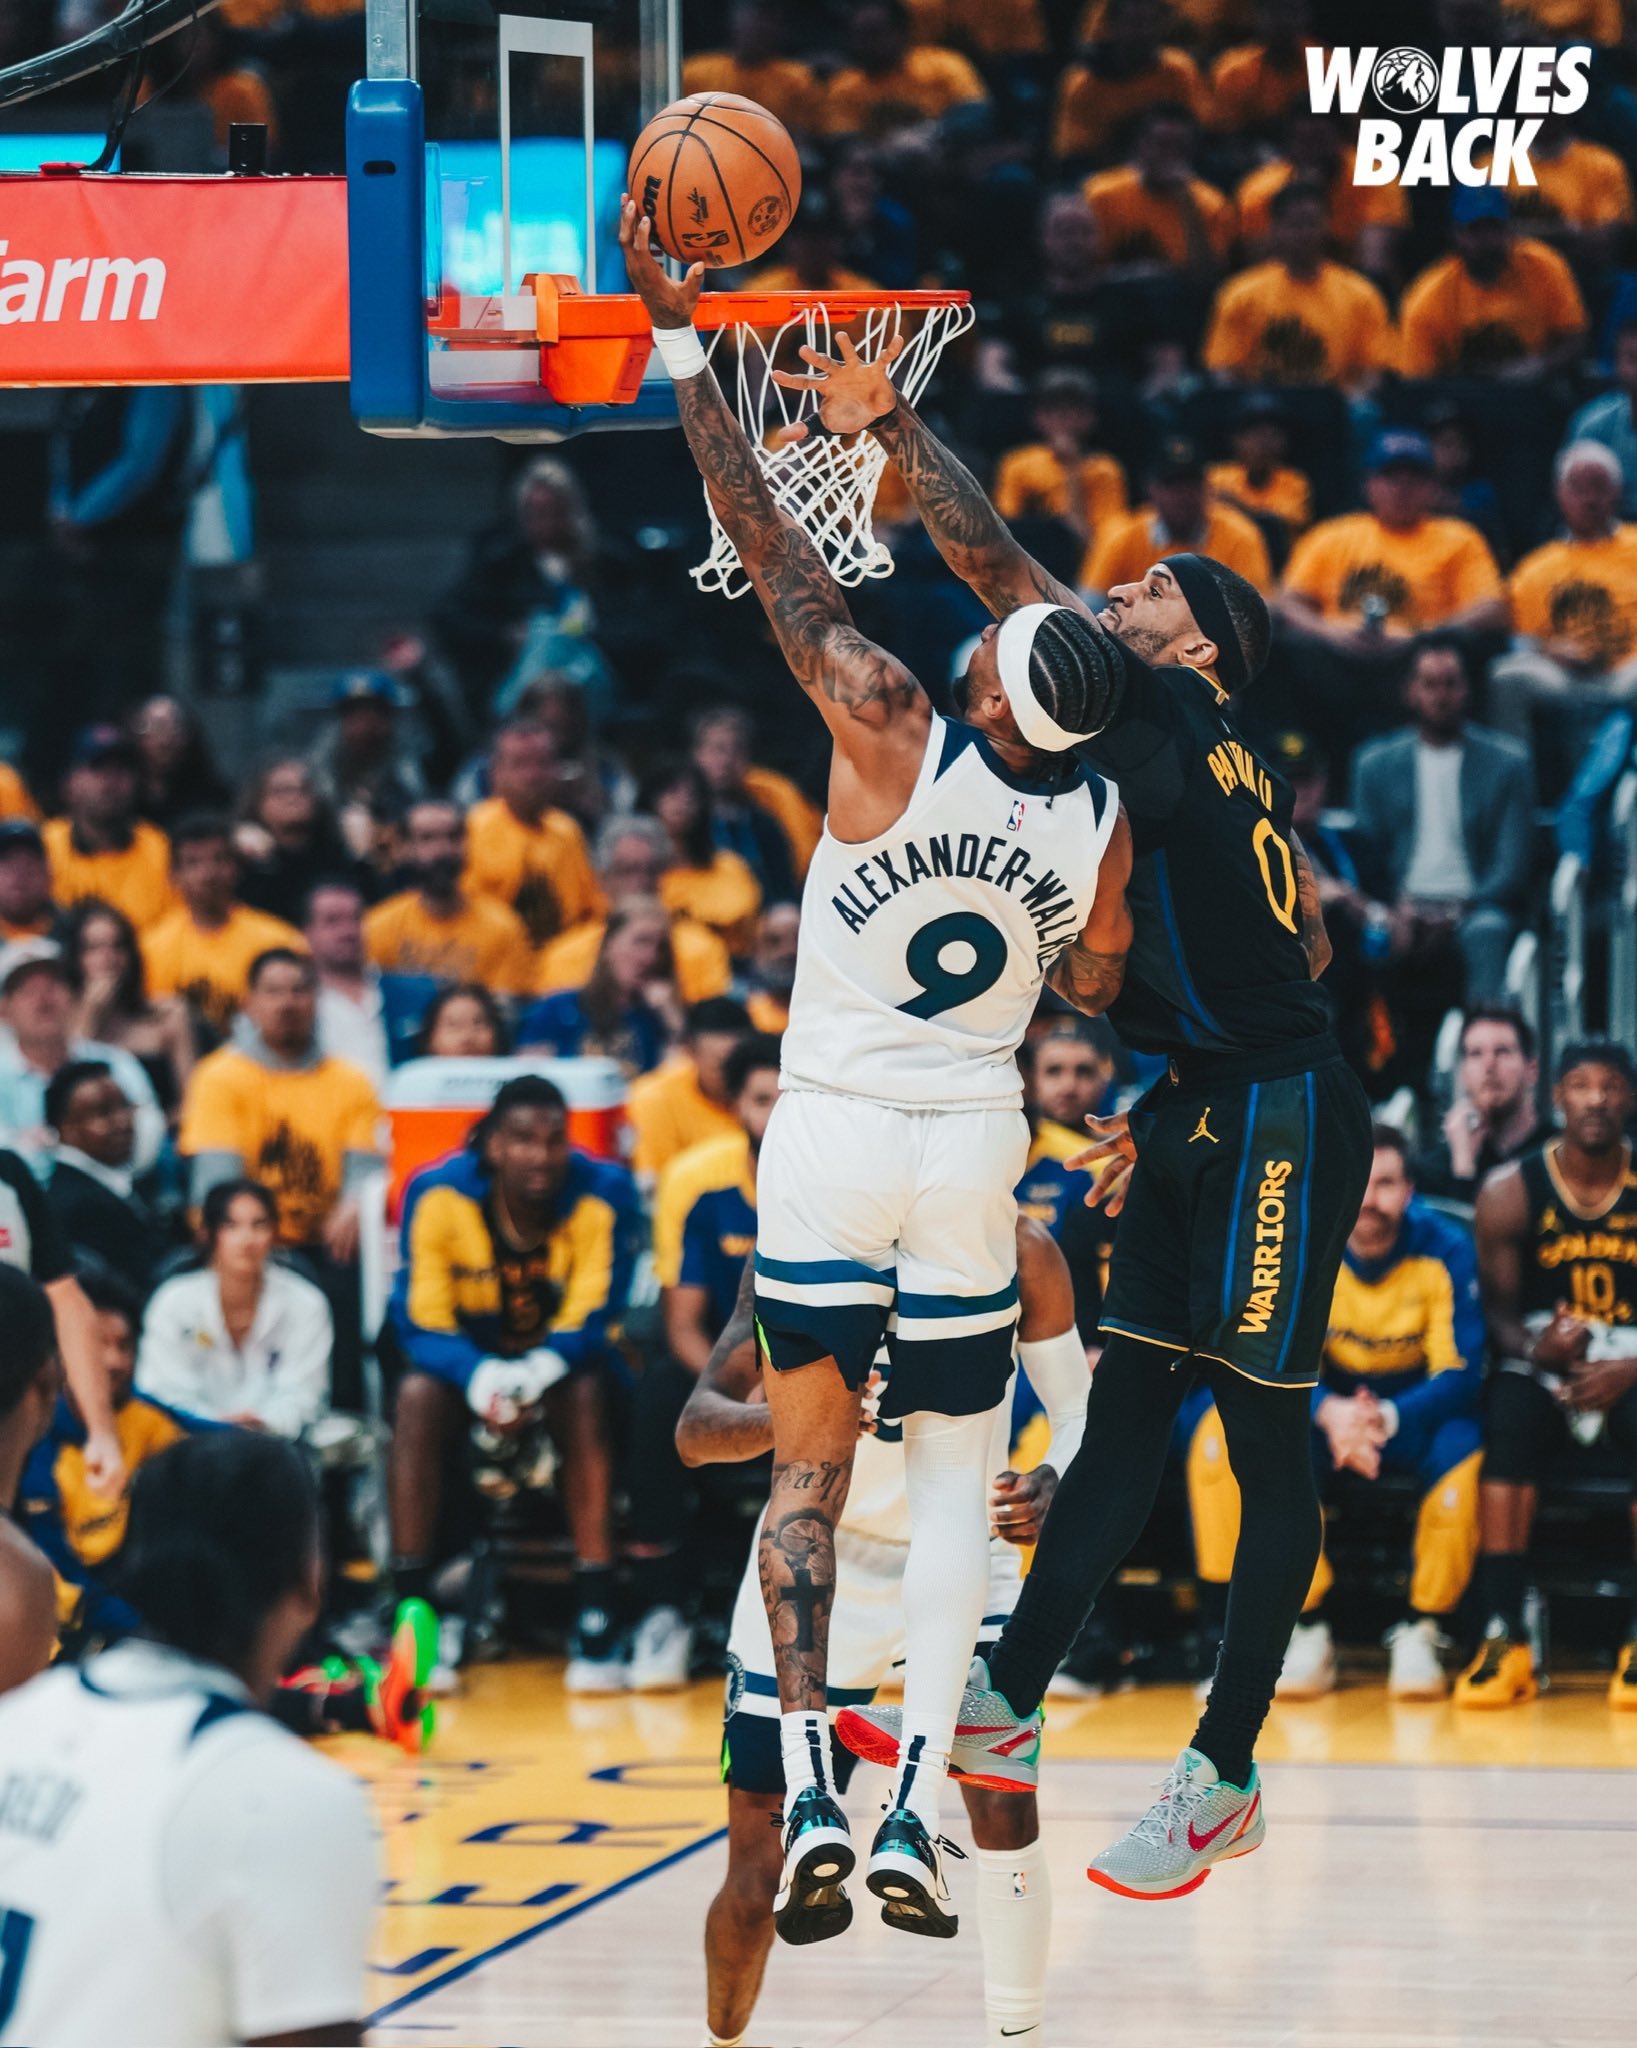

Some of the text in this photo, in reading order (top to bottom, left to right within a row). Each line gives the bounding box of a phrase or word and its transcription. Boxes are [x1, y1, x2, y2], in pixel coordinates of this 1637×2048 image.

[0, 240, 167, 325] arm
[1252, 817, 1298, 934] 0
[894, 911, 1008, 1021] 9
[1237, 1160, 1293, 1334] WARRIORS
